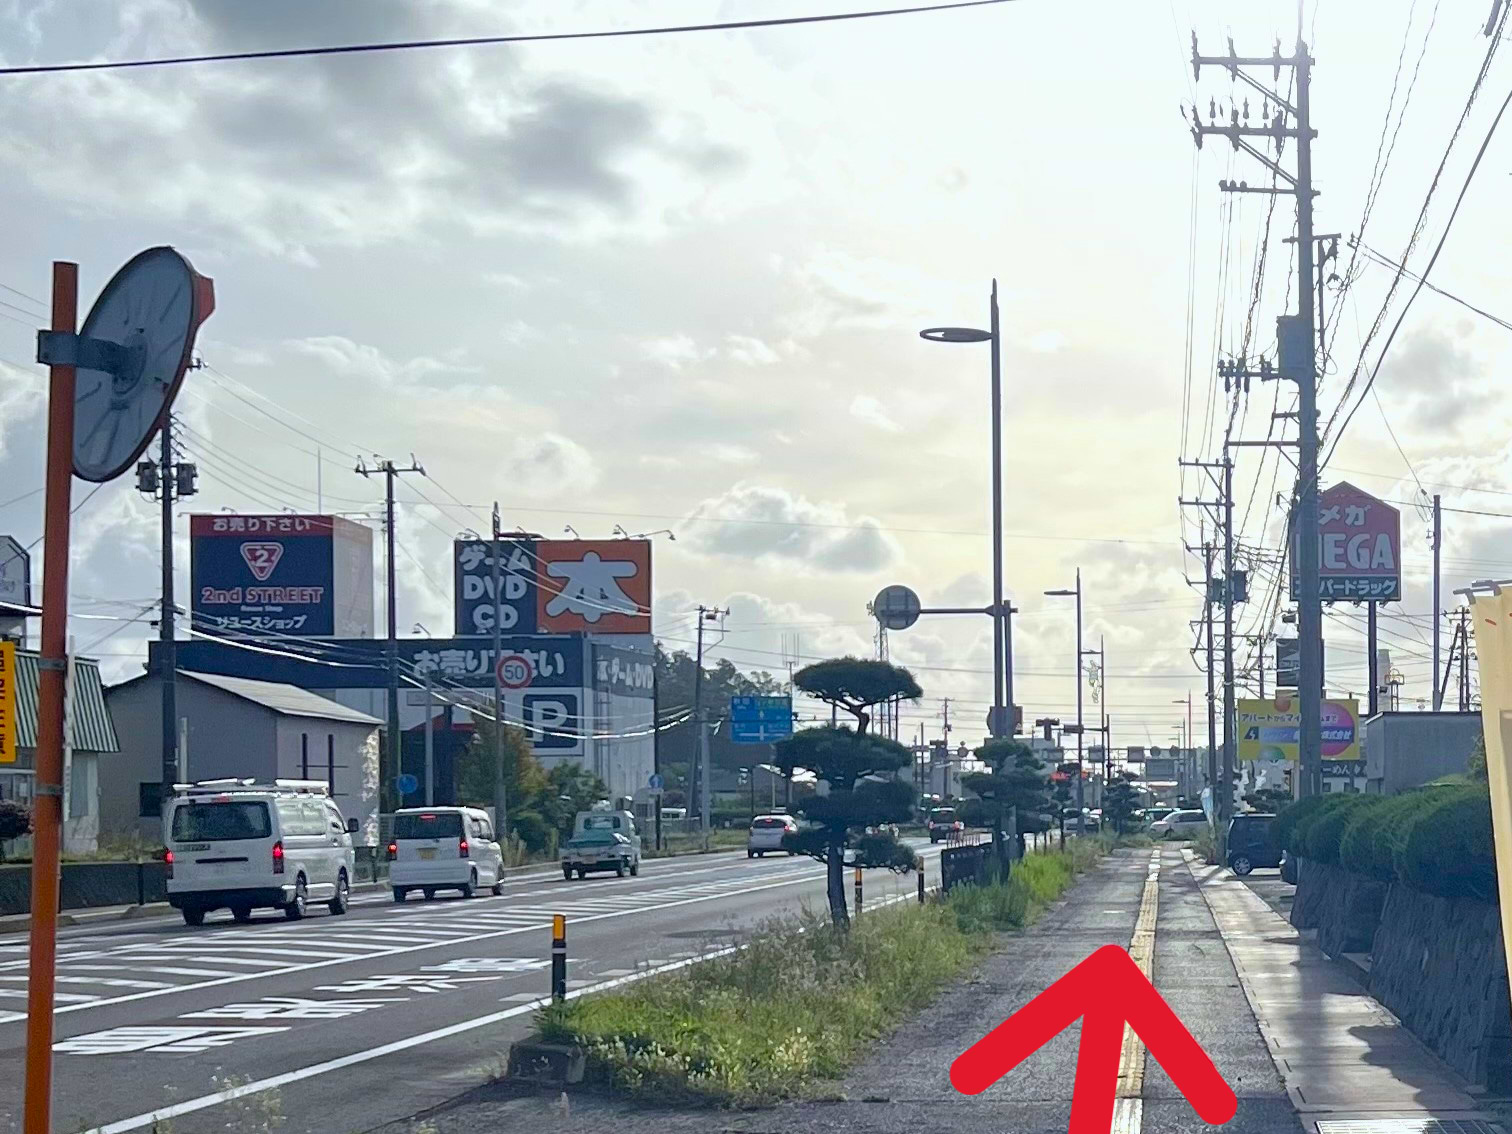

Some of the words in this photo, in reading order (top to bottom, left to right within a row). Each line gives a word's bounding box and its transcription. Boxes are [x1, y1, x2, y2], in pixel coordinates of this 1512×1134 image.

[213, 517, 312, 532] お売り下さい
[1318, 504, 1372, 526] メガ
[460, 545, 531, 571] ゲーム
[201, 587, 242, 604] 2nd
[245, 587, 324, 604] STREET
[463, 575, 528, 600] DVD
[546, 551, 638, 623] 本
[472, 604, 518, 629] CD
[504, 664, 525, 680] 50
[531, 700, 568, 742] P
